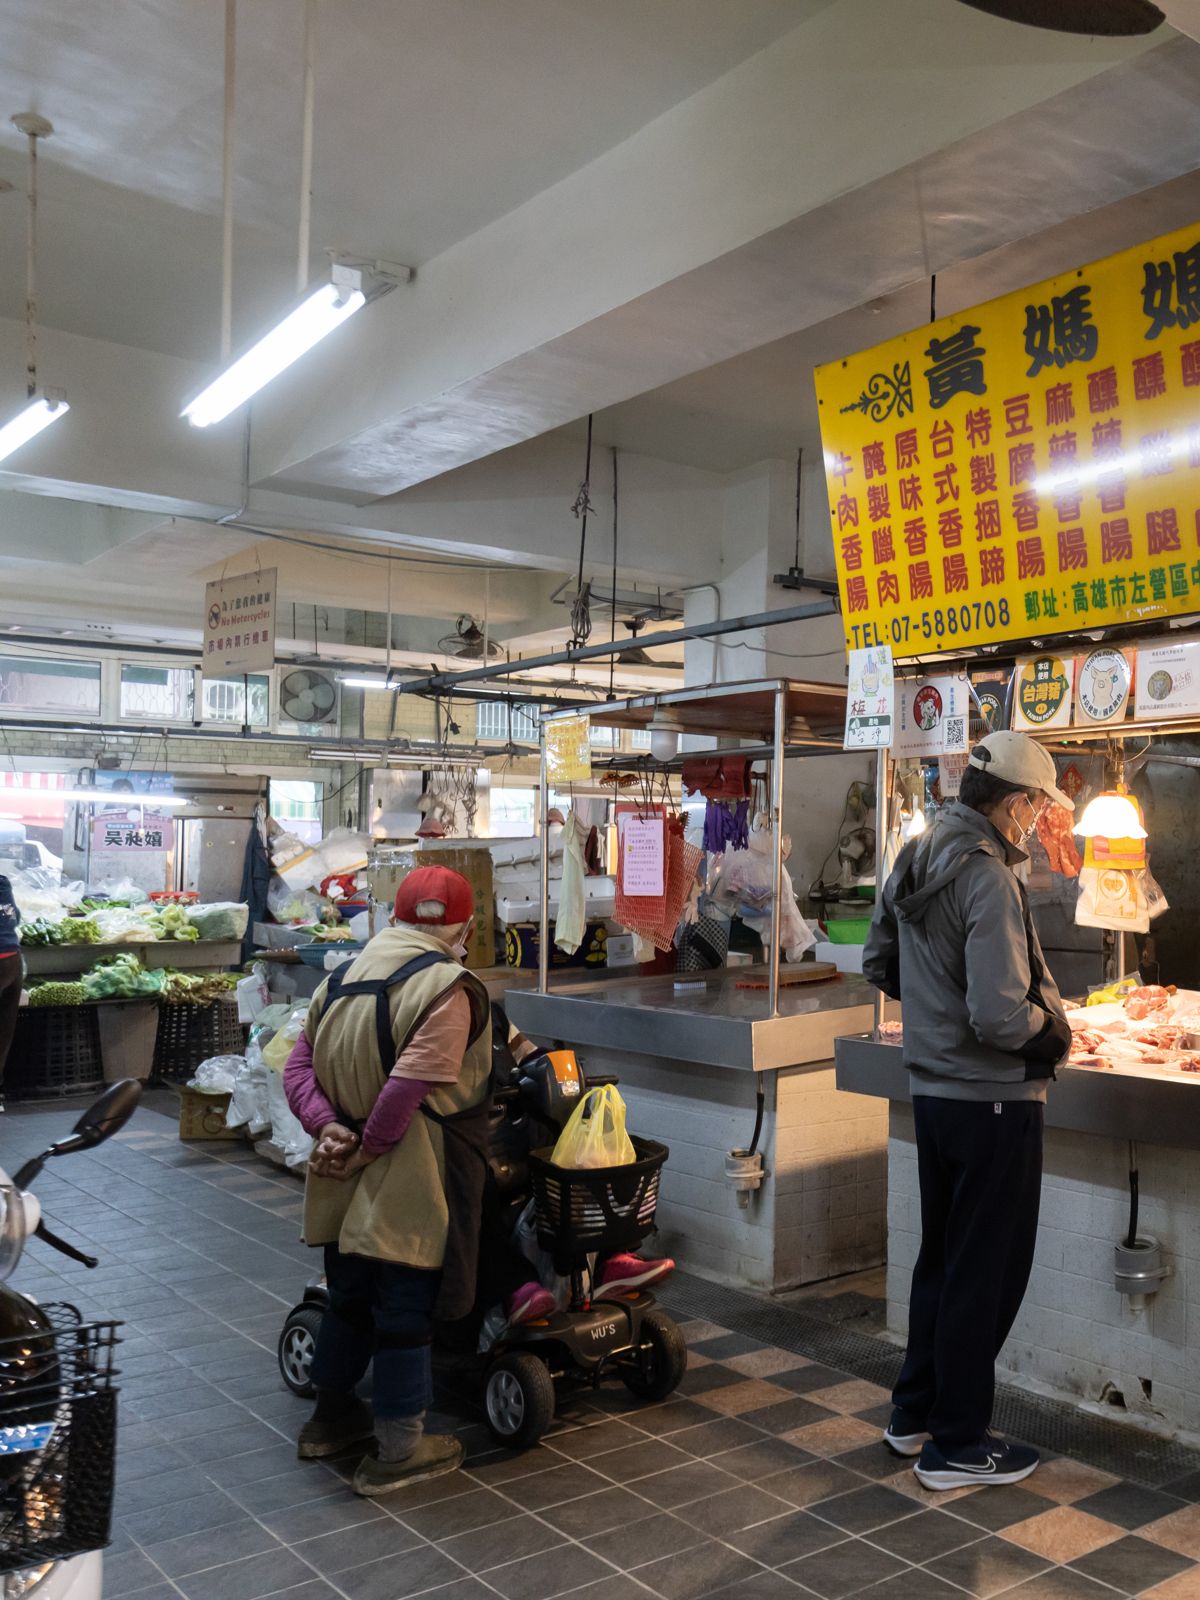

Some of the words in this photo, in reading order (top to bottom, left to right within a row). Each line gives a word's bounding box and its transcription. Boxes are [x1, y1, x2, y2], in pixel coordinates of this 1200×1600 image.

[832, 451, 869, 614] 牛肉香腸
[895, 428, 933, 601] 原味香腸
[929, 419, 969, 594] 台式香腸
[965, 407, 1005, 587] 特製捆蹄
[1003, 393, 1046, 581] 豆腐香腸
[1045, 382, 1088, 573] 麻辣香腸
[851, 598, 1010, 650] TEL:07-5880708
[1023, 681, 1062, 703] 台灣豬
